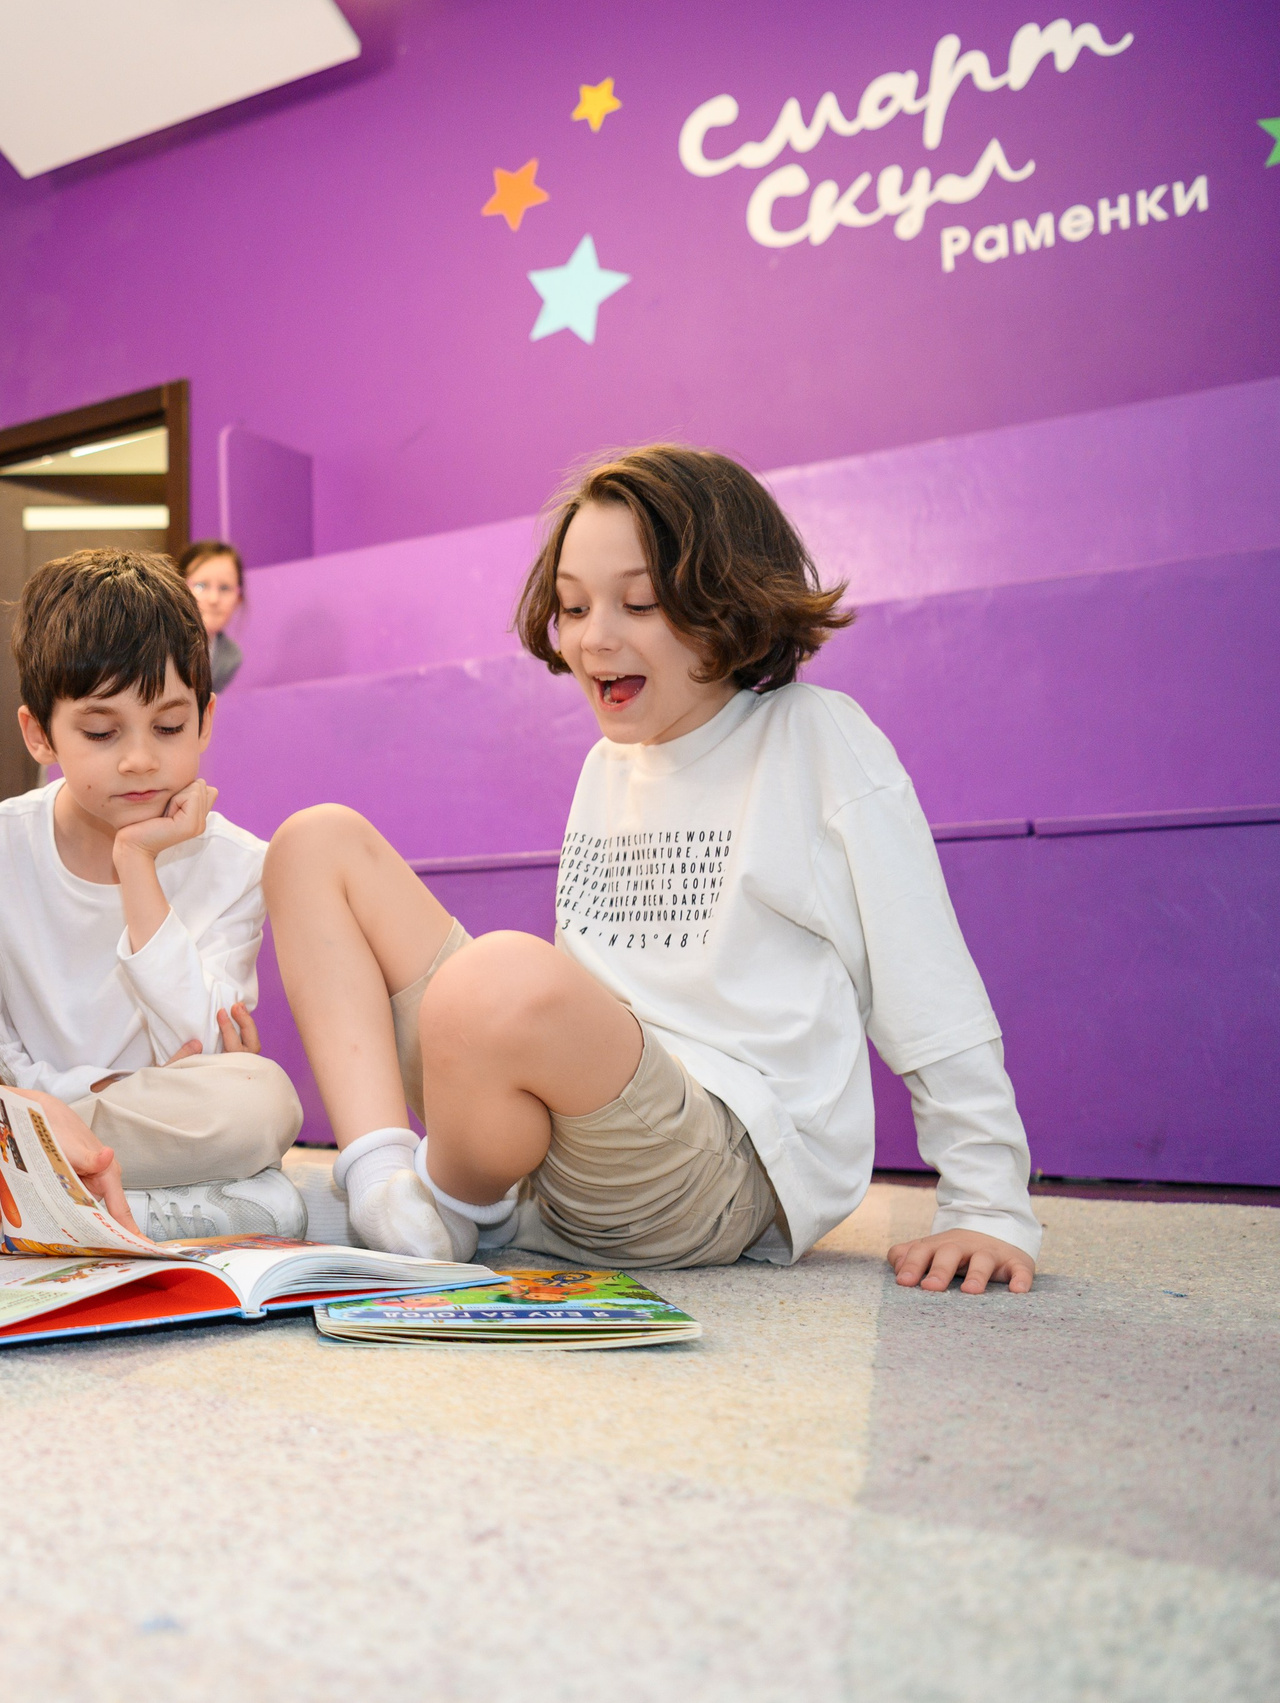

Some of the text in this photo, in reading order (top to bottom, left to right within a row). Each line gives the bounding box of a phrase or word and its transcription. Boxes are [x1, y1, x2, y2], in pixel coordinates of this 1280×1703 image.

[678, 18, 1134, 178] Смарт
[746, 138, 1036, 249] Скул
[659, 831, 679, 844] THE
[686, 830, 732, 843] WORLD
[704, 845, 730, 858] AND
[645, 862, 666, 875] JUST
[626, 879, 654, 891] THING
[661, 878, 672, 890] IS
[672, 893, 705, 905] DARE
[628, 910, 654, 922] YOUR
[383, 1310, 472, 1318] ГОРОД
